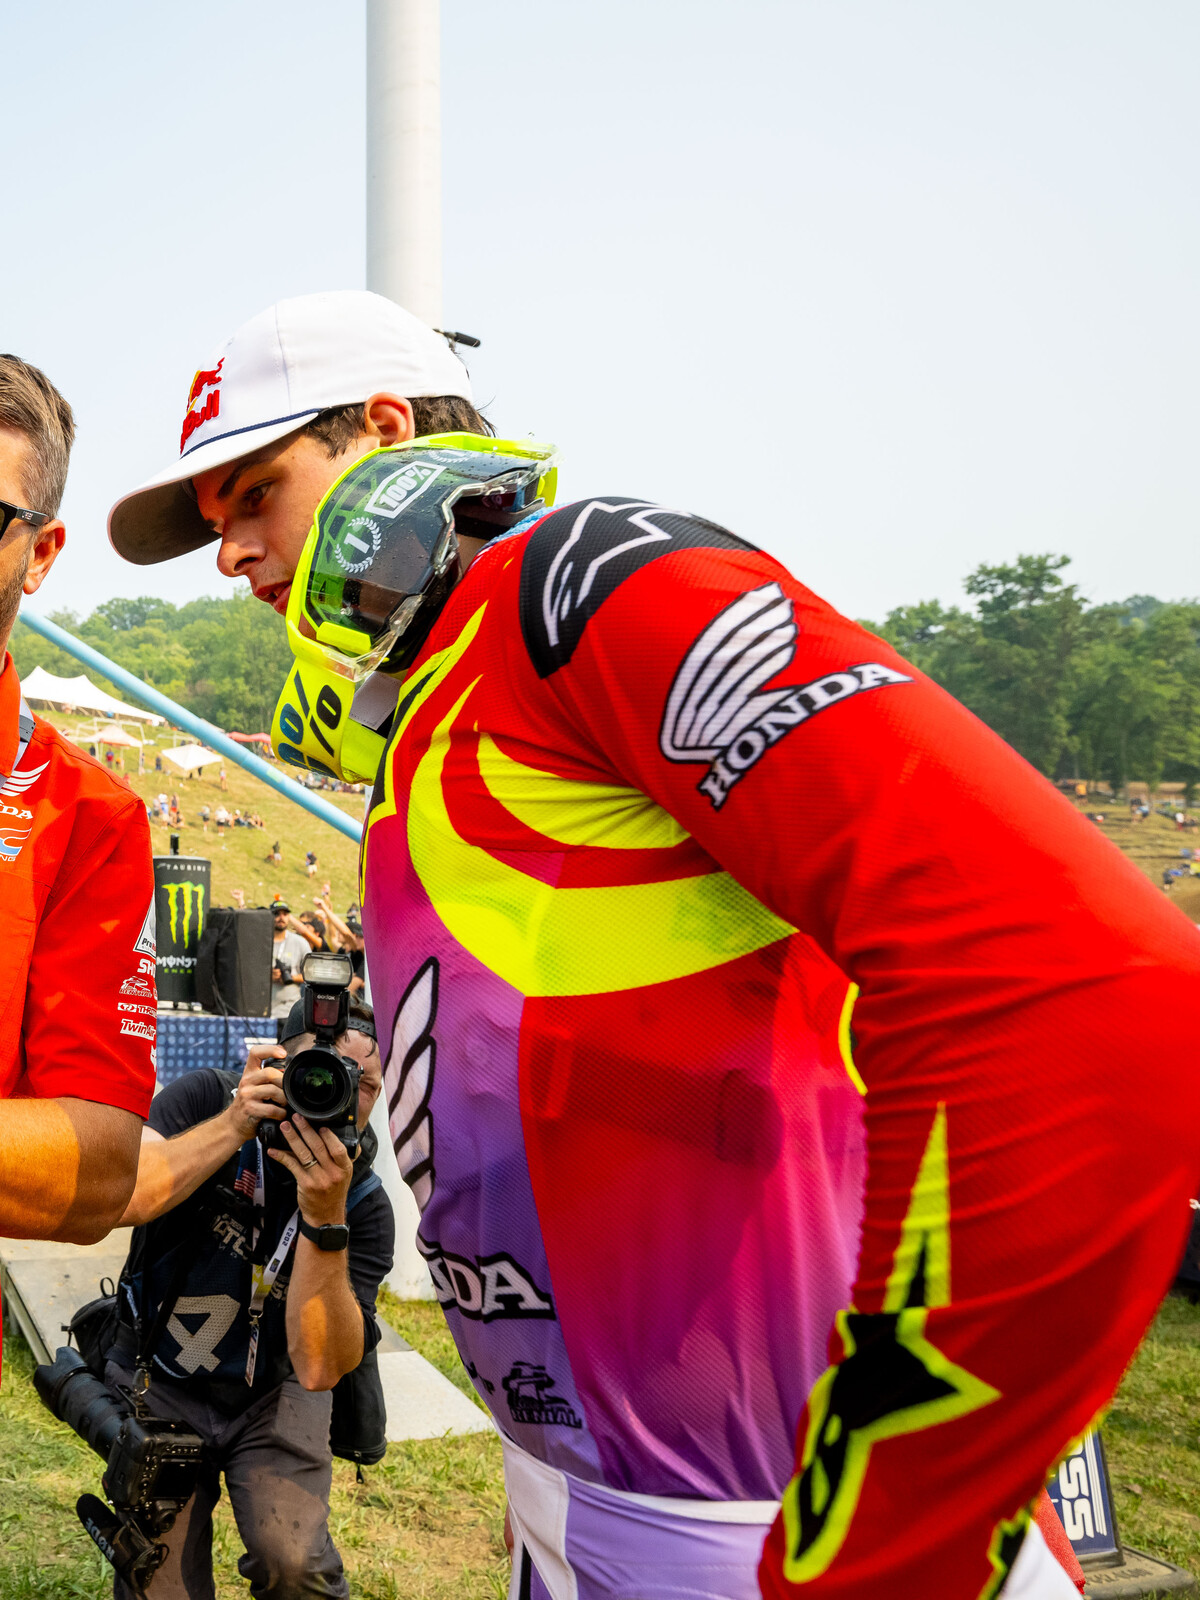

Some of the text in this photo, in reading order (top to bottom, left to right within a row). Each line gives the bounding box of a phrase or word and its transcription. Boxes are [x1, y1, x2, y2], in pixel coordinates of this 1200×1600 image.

[379, 465, 433, 509] 100%
[343, 532, 370, 554] 1
[700, 661, 913, 808] HONDA
[166, 1294, 241, 1376] 4
